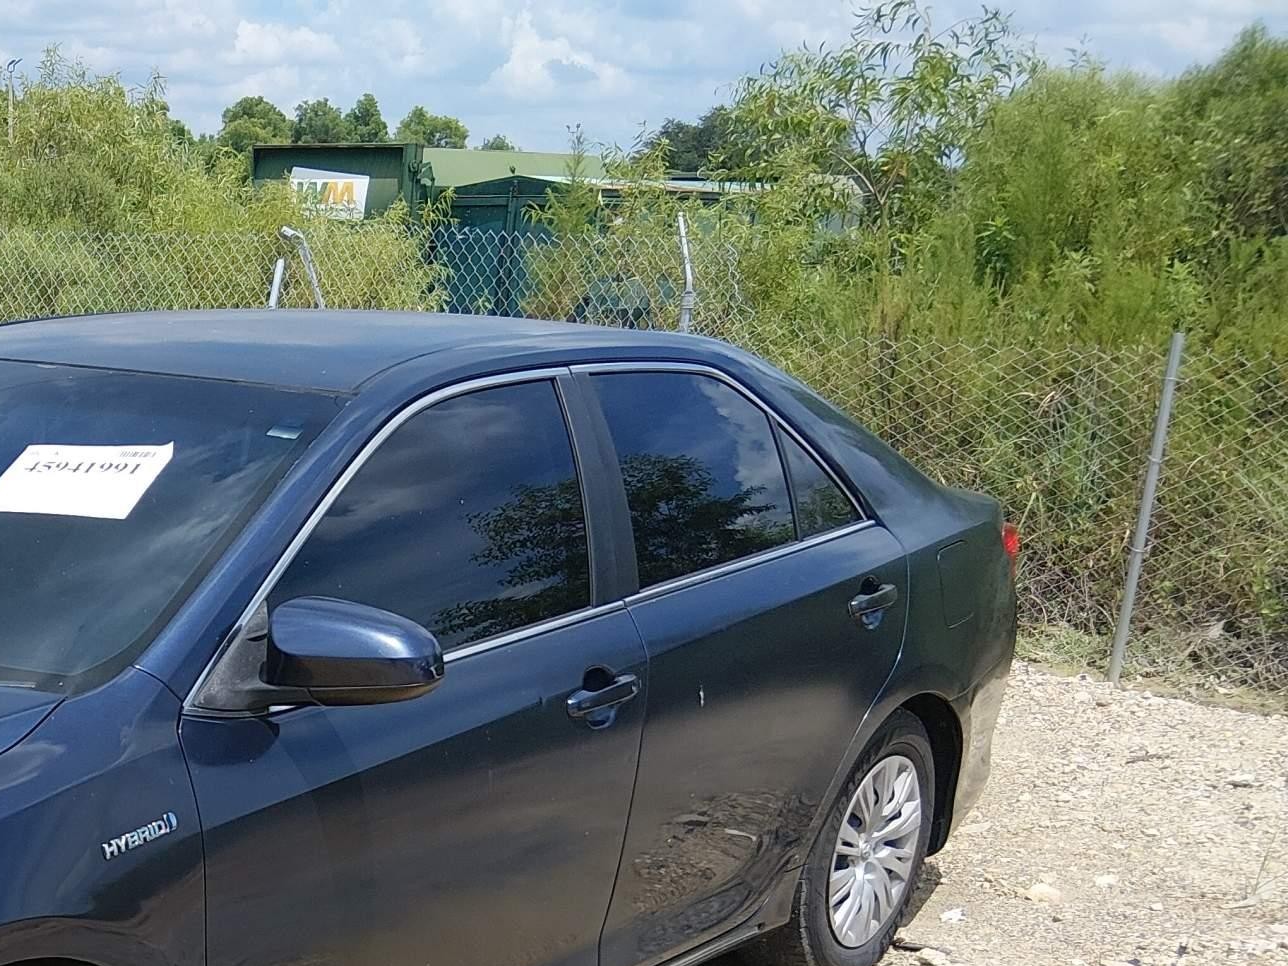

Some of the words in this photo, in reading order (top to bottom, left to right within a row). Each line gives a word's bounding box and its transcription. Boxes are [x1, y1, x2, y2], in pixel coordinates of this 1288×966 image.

[296, 181, 355, 205] WM
[24, 460, 142, 475] 45941991
[102, 819, 170, 860] HYBRID
